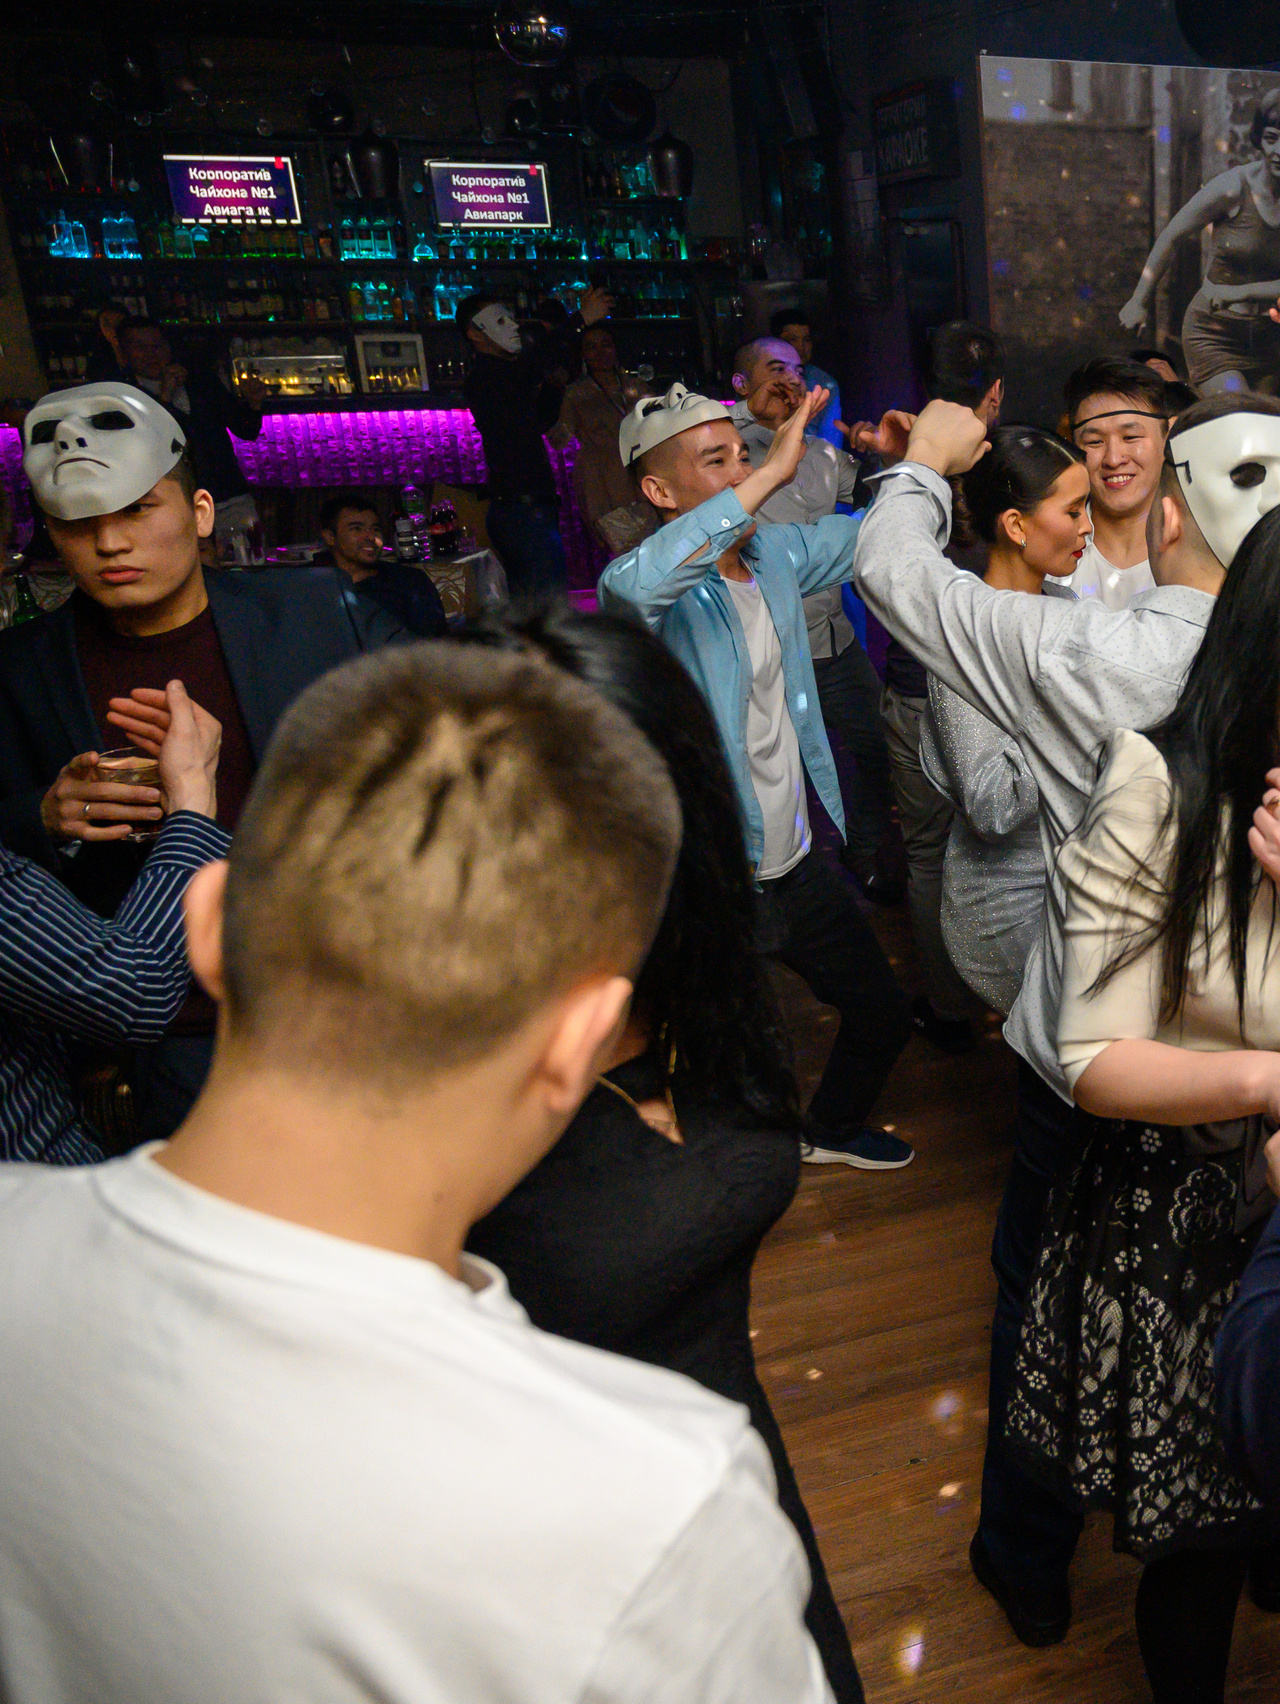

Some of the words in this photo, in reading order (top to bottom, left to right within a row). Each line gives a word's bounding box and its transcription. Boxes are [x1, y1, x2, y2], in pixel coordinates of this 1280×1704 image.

[188, 167, 272, 183] Корпоратив
[451, 174, 527, 188] Корпоратив
[189, 185, 249, 198] Чайхона
[250, 186, 277, 199] №1
[452, 191, 505, 203] Чайхона
[506, 192, 530, 204] №1
[464, 208, 524, 222] Авиапарк
